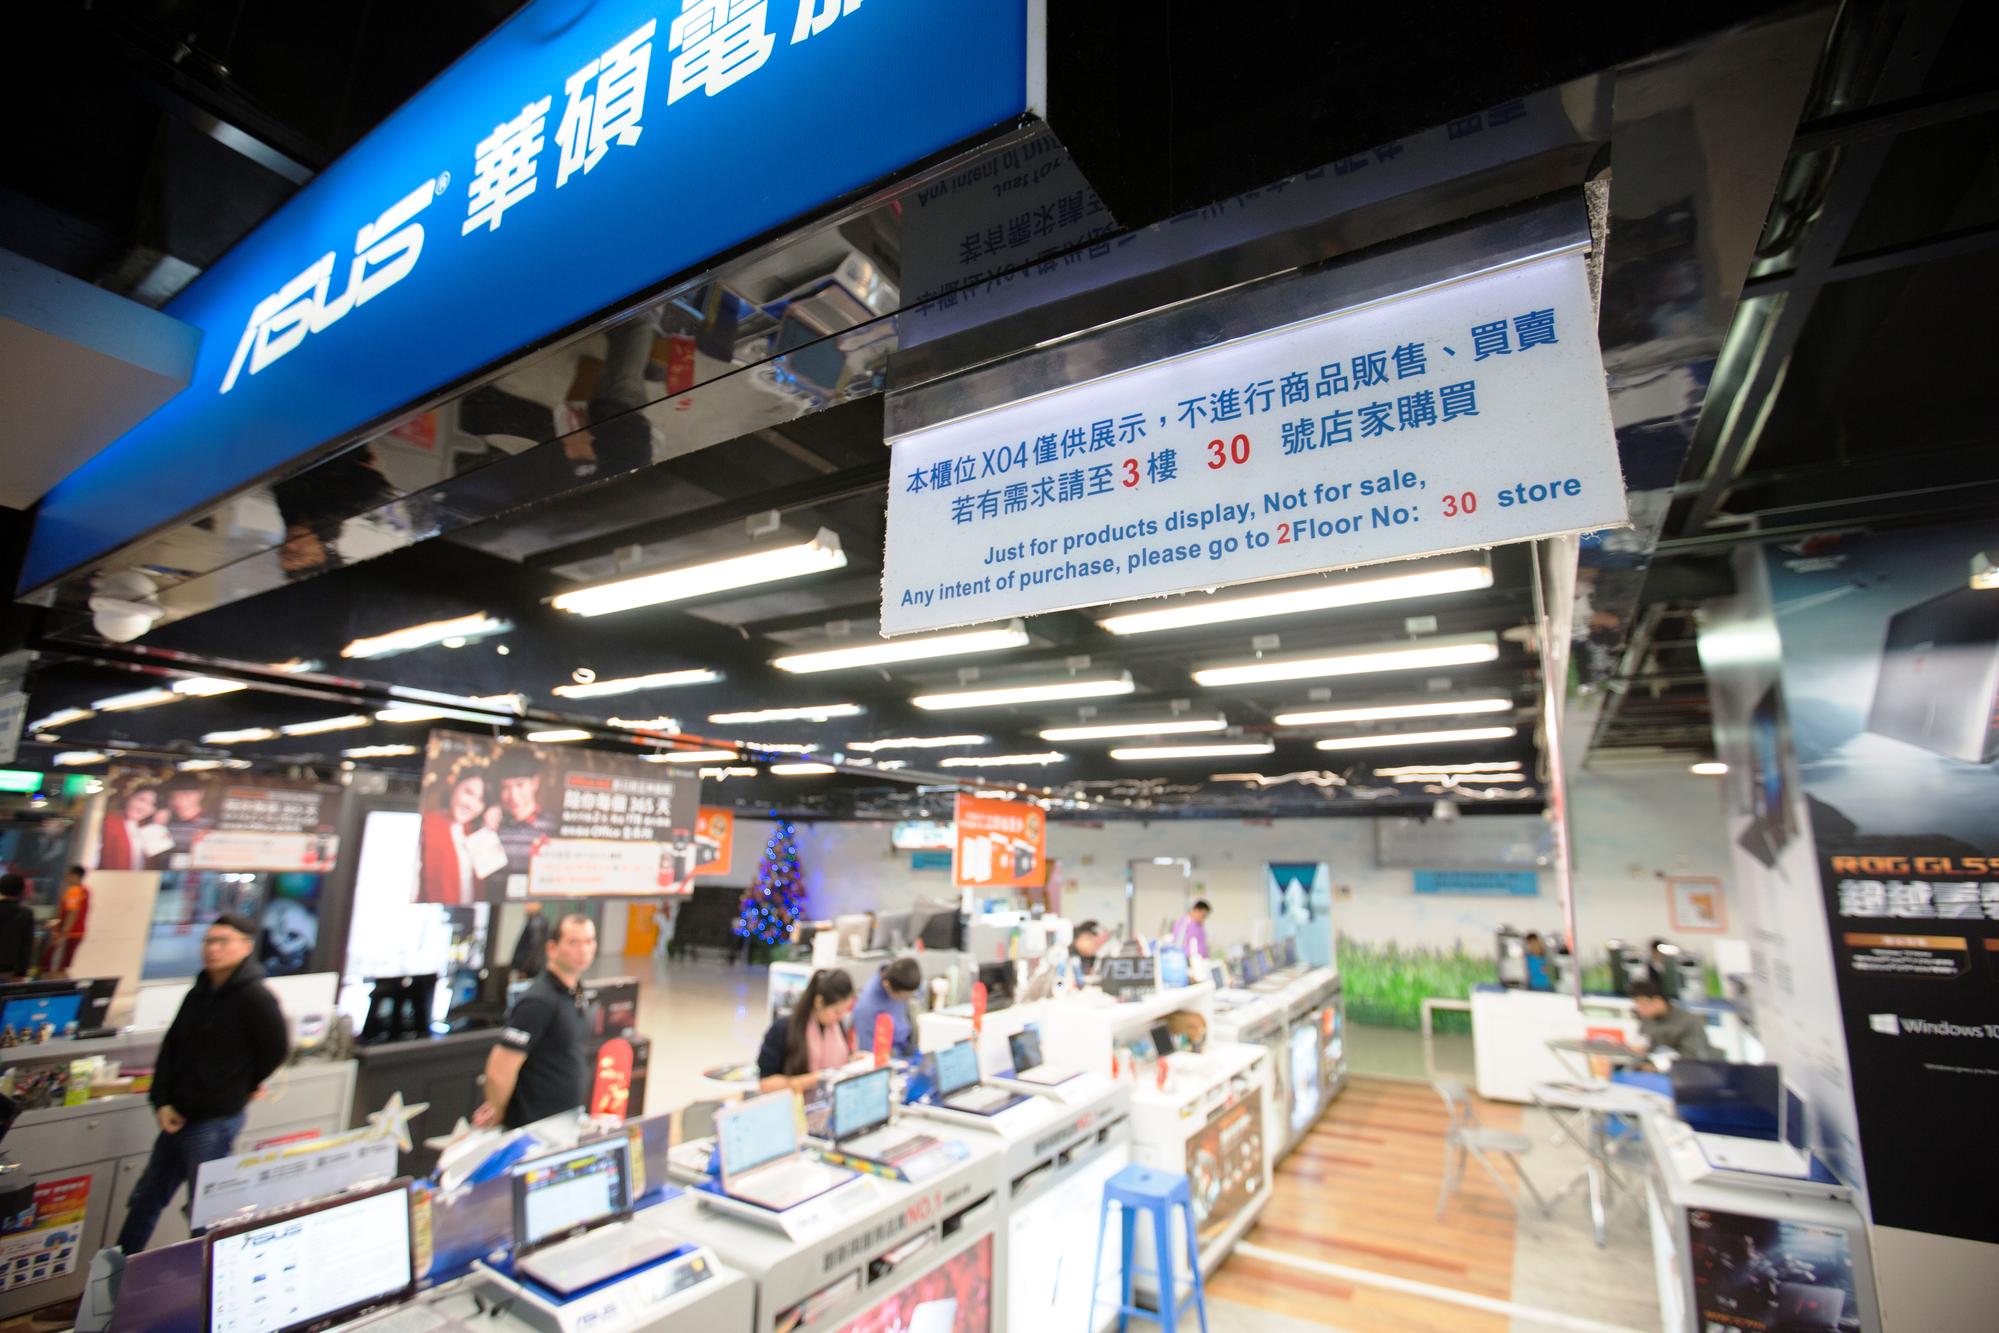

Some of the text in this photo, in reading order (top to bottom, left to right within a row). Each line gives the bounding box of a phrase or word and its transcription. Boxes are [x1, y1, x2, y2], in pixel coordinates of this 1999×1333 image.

[219, 177, 437, 395] ASUS
[1206, 433, 1252, 470] 30
[1281, 380, 1480, 456] 號店家購買
[901, 587, 935, 607] Any
[939, 575, 991, 600] intent
[995, 571, 1017, 591] of
[1020, 554, 1122, 590] purchase,
[1127, 541, 1202, 572] please
[1208, 533, 1239, 560] go
[1245, 525, 1270, 549] to
[1371, 504, 1420, 530] No:
[1441, 490, 1478, 518] 30
[1496, 474, 1583, 509] store
[984, 468, 1427, 566] Just for products display, Not for sale,
[1831, 855, 1910, 876] ROG
